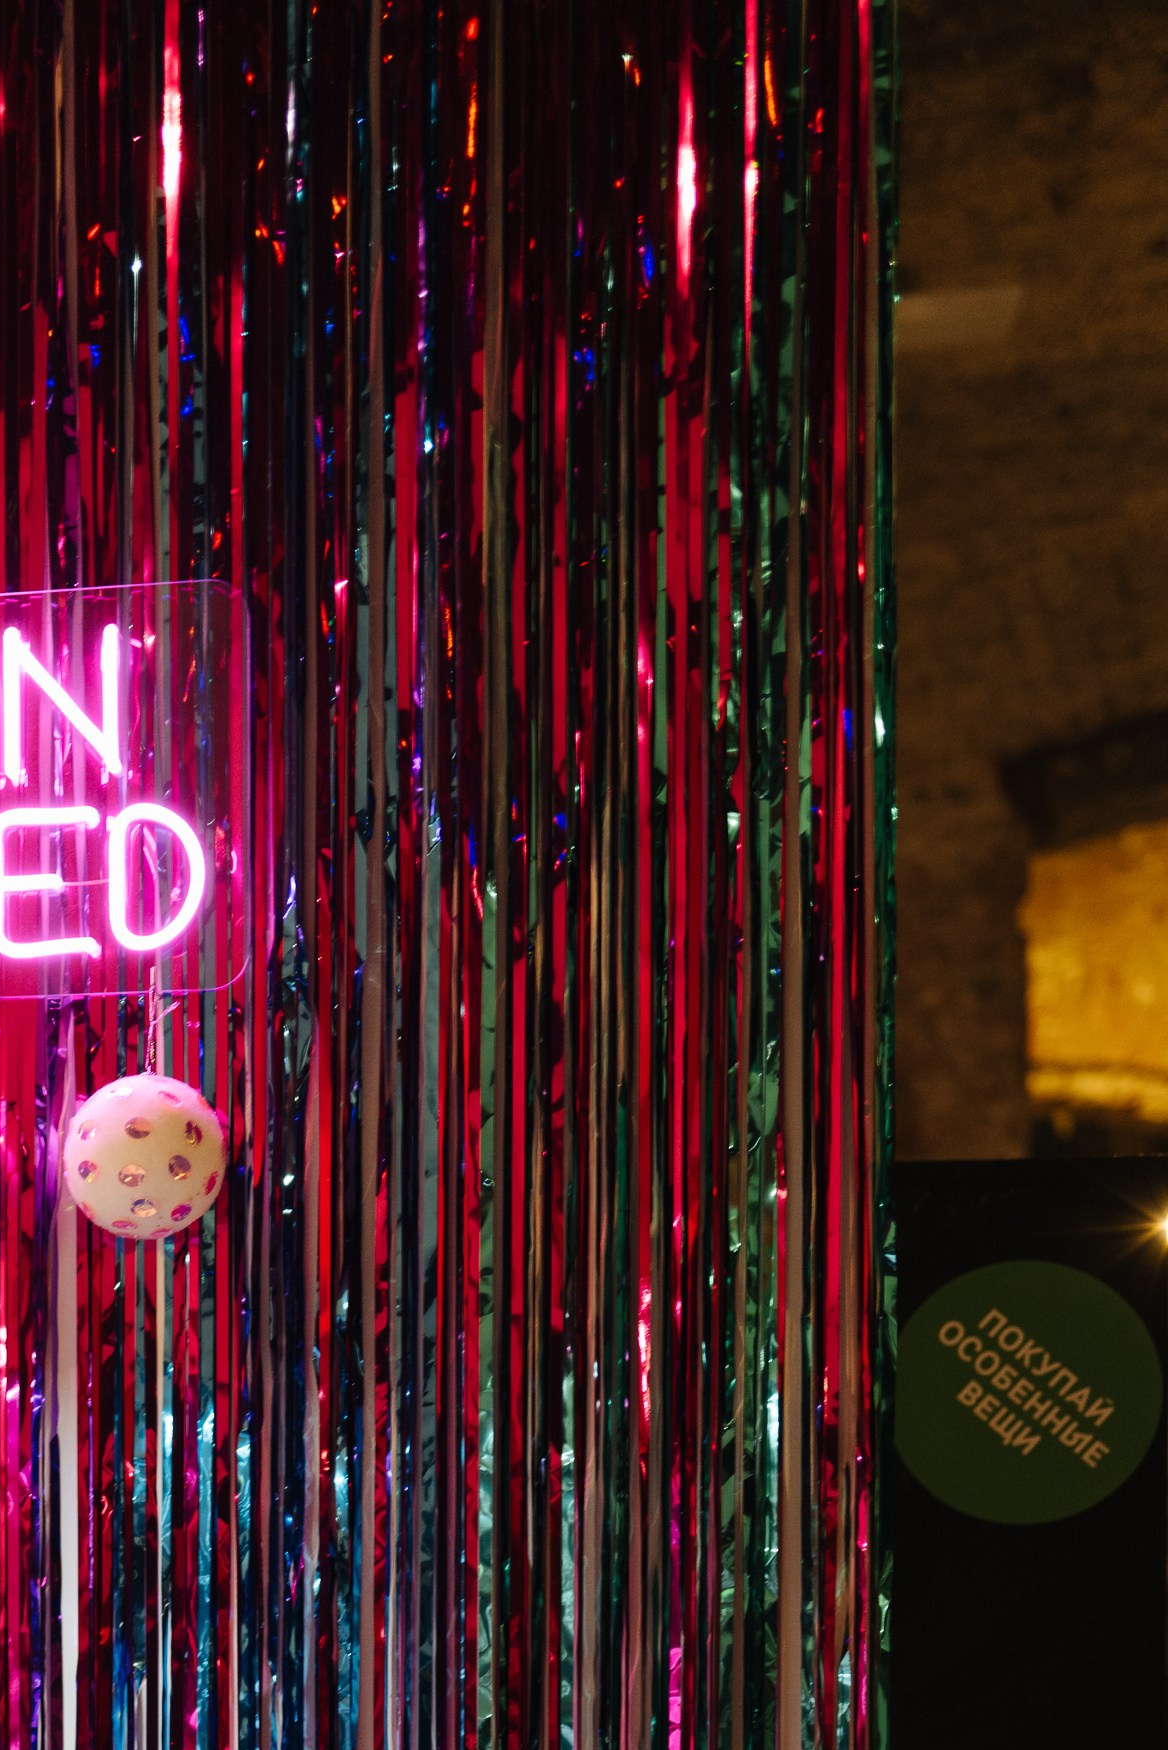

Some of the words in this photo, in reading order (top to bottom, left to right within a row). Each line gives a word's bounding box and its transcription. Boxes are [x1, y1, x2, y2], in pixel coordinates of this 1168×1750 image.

[938, 1320, 1110, 1468] ОСОБЕННЫЕ
[956, 1380, 1042, 1455] ВЕЩИ
[978, 1308, 1115, 1428] ПОКУПАЙ
